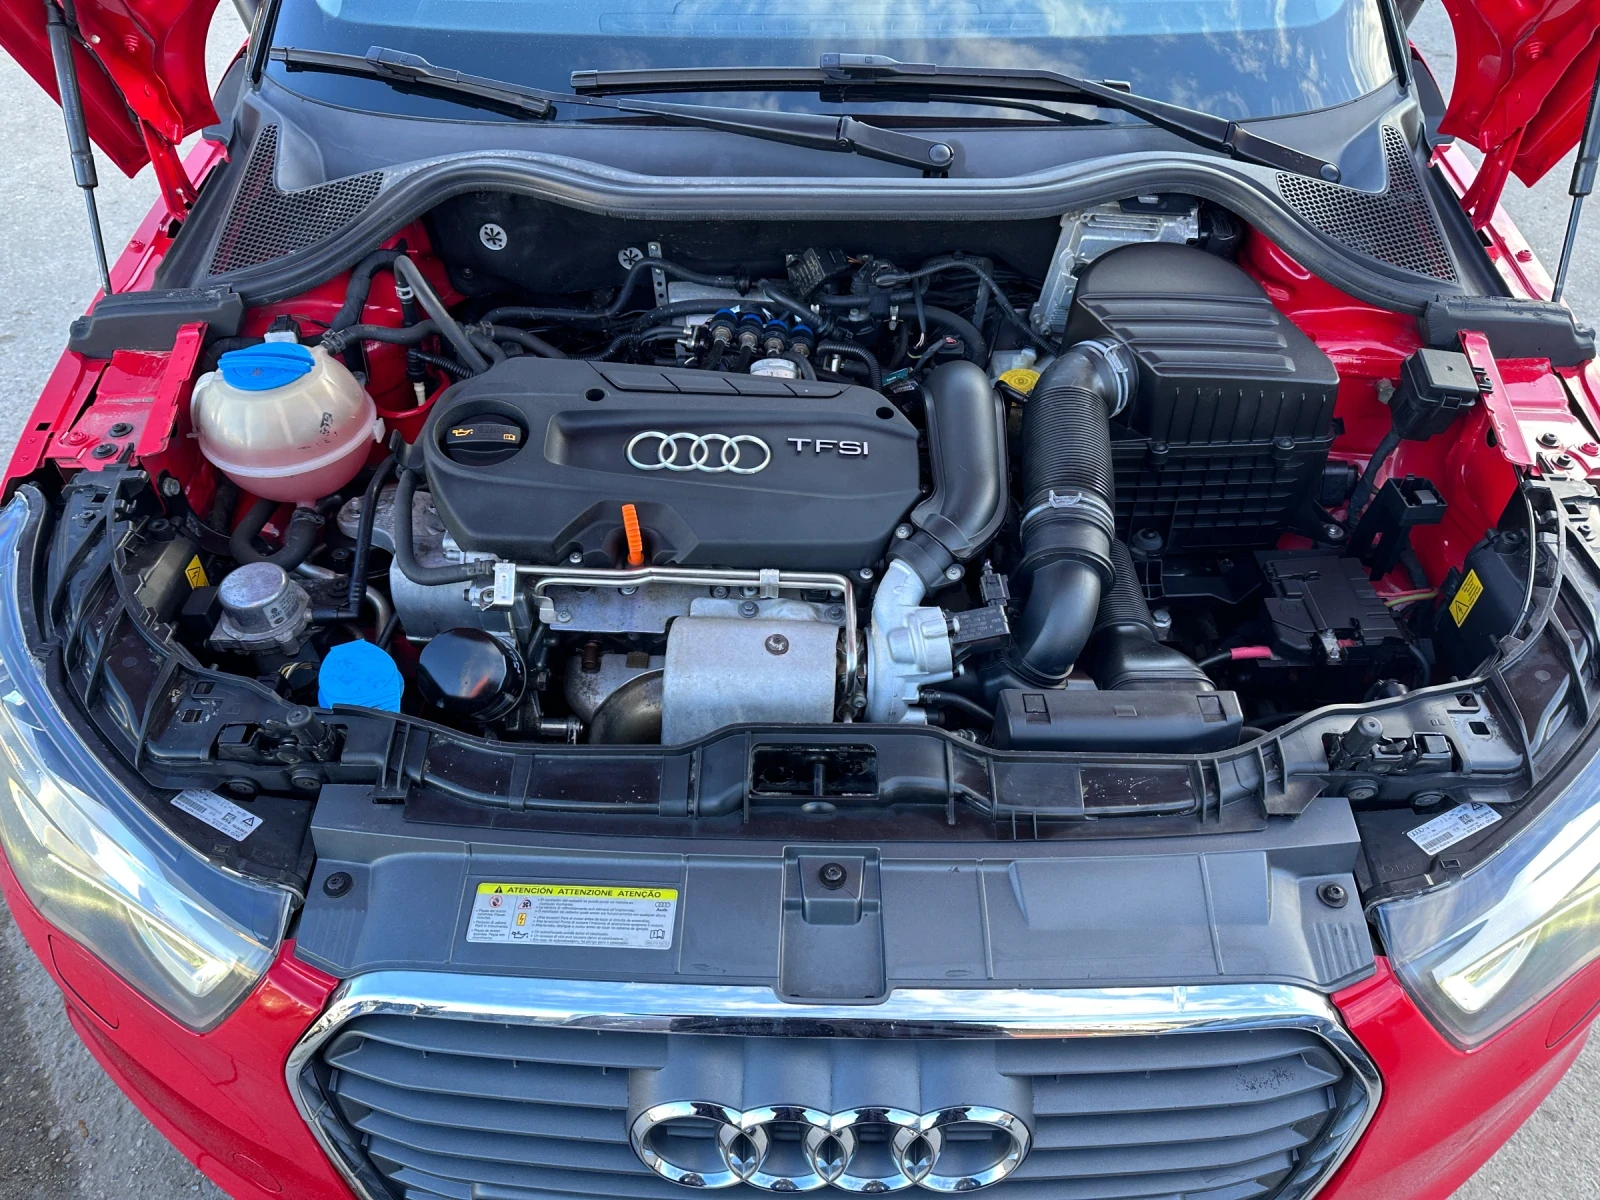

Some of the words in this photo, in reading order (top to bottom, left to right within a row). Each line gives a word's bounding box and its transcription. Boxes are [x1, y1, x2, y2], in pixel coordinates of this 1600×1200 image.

[787, 438, 869, 455] TFSI
[507, 886, 553, 894] ATENCIÓN
[557, 888, 613, 896] ATTENZIONE
[617, 890, 662, 898] ATENÇÃO
